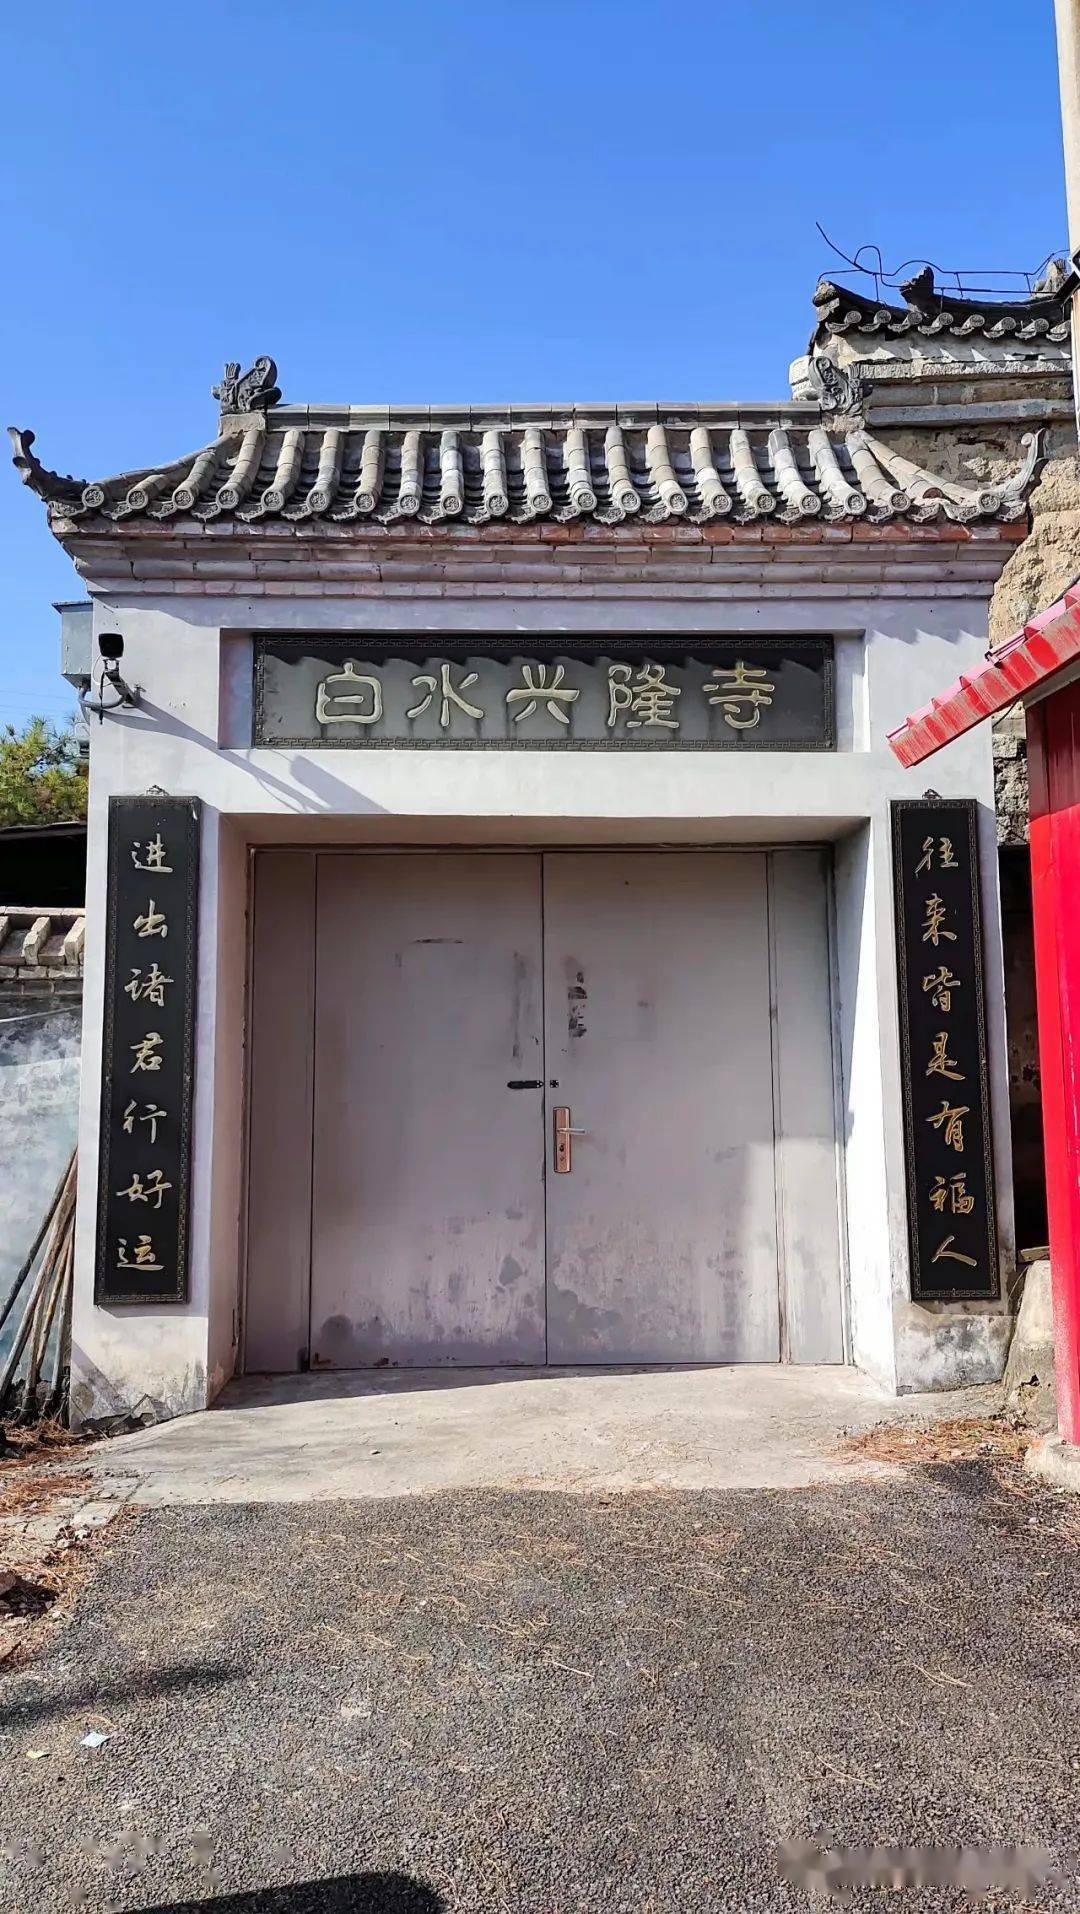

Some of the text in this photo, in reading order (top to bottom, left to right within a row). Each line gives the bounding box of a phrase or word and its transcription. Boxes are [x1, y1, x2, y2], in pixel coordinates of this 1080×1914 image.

[315, 662, 775, 728] 白水兴隆寺
[116, 833, 175, 1271] 进出诸君行好运
[915, 836, 977, 1267] 往来皆是有福人
